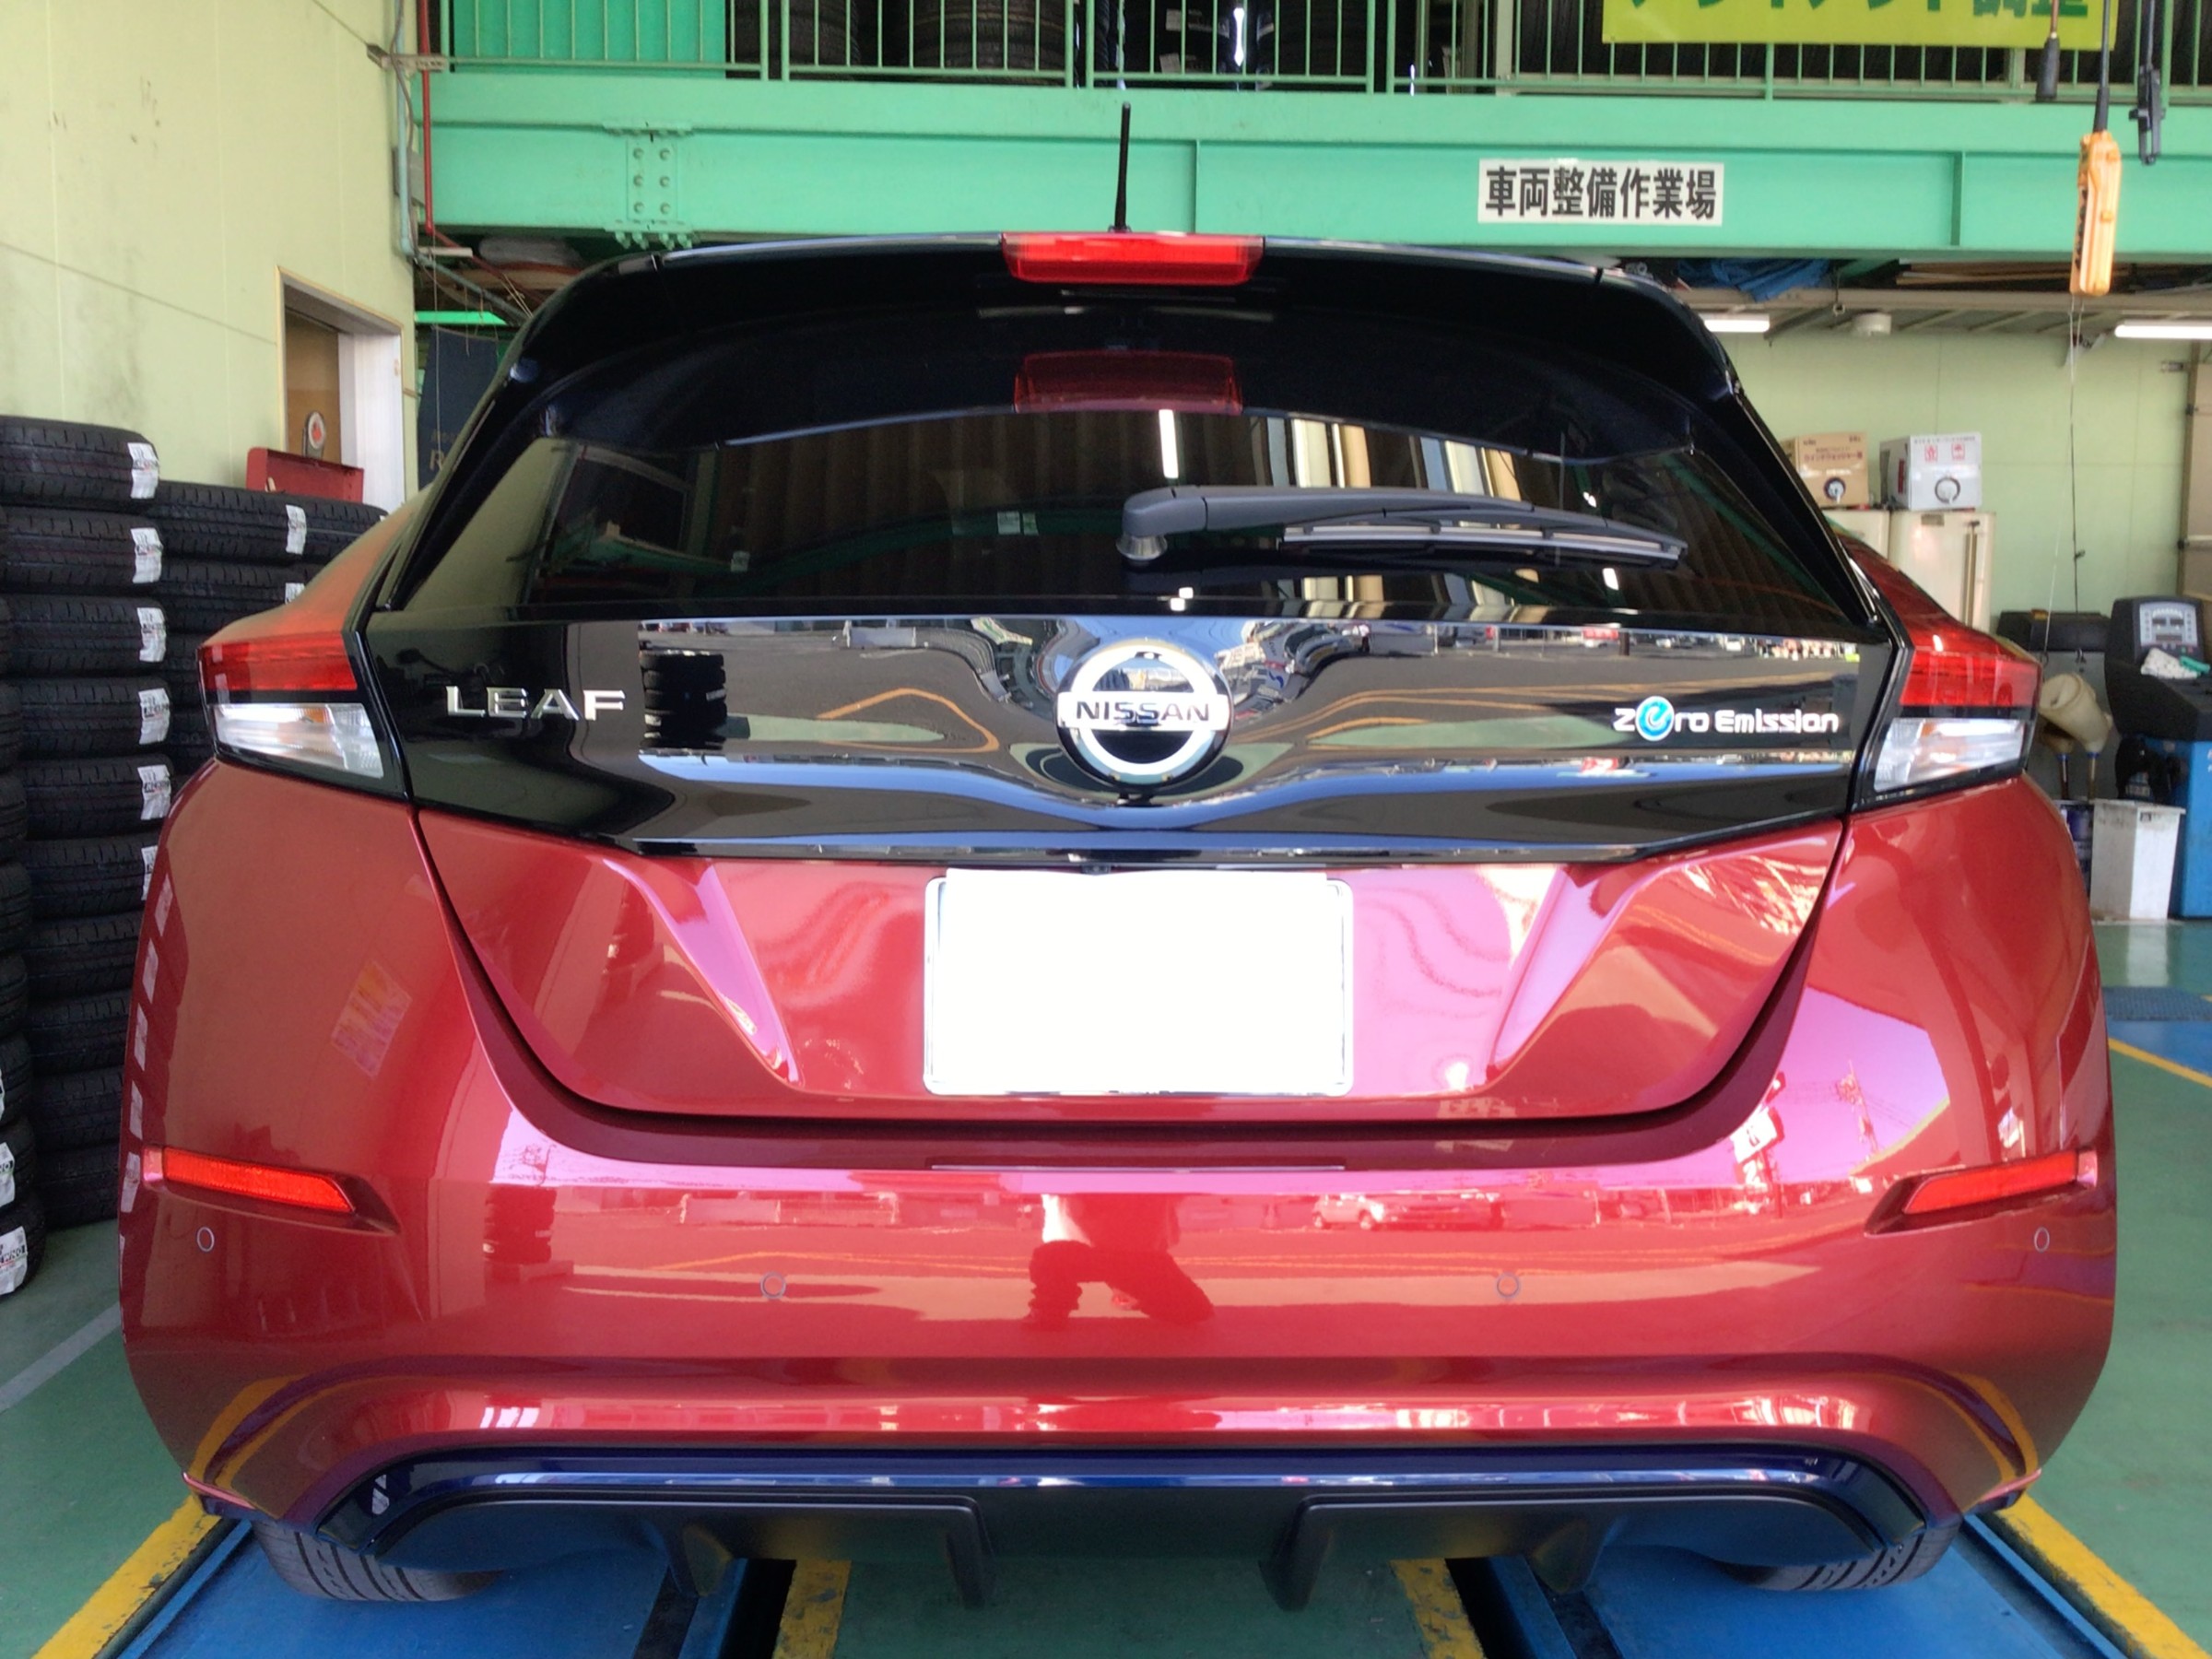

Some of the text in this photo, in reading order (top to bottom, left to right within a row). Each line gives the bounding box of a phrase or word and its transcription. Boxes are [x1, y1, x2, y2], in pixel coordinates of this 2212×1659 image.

[1485, 165, 1716, 219] 車両整備作業場
[446, 686, 626, 721] LEAF
[1077, 700, 1209, 723] NISSAN
[1714, 709, 1840, 734] Emission
